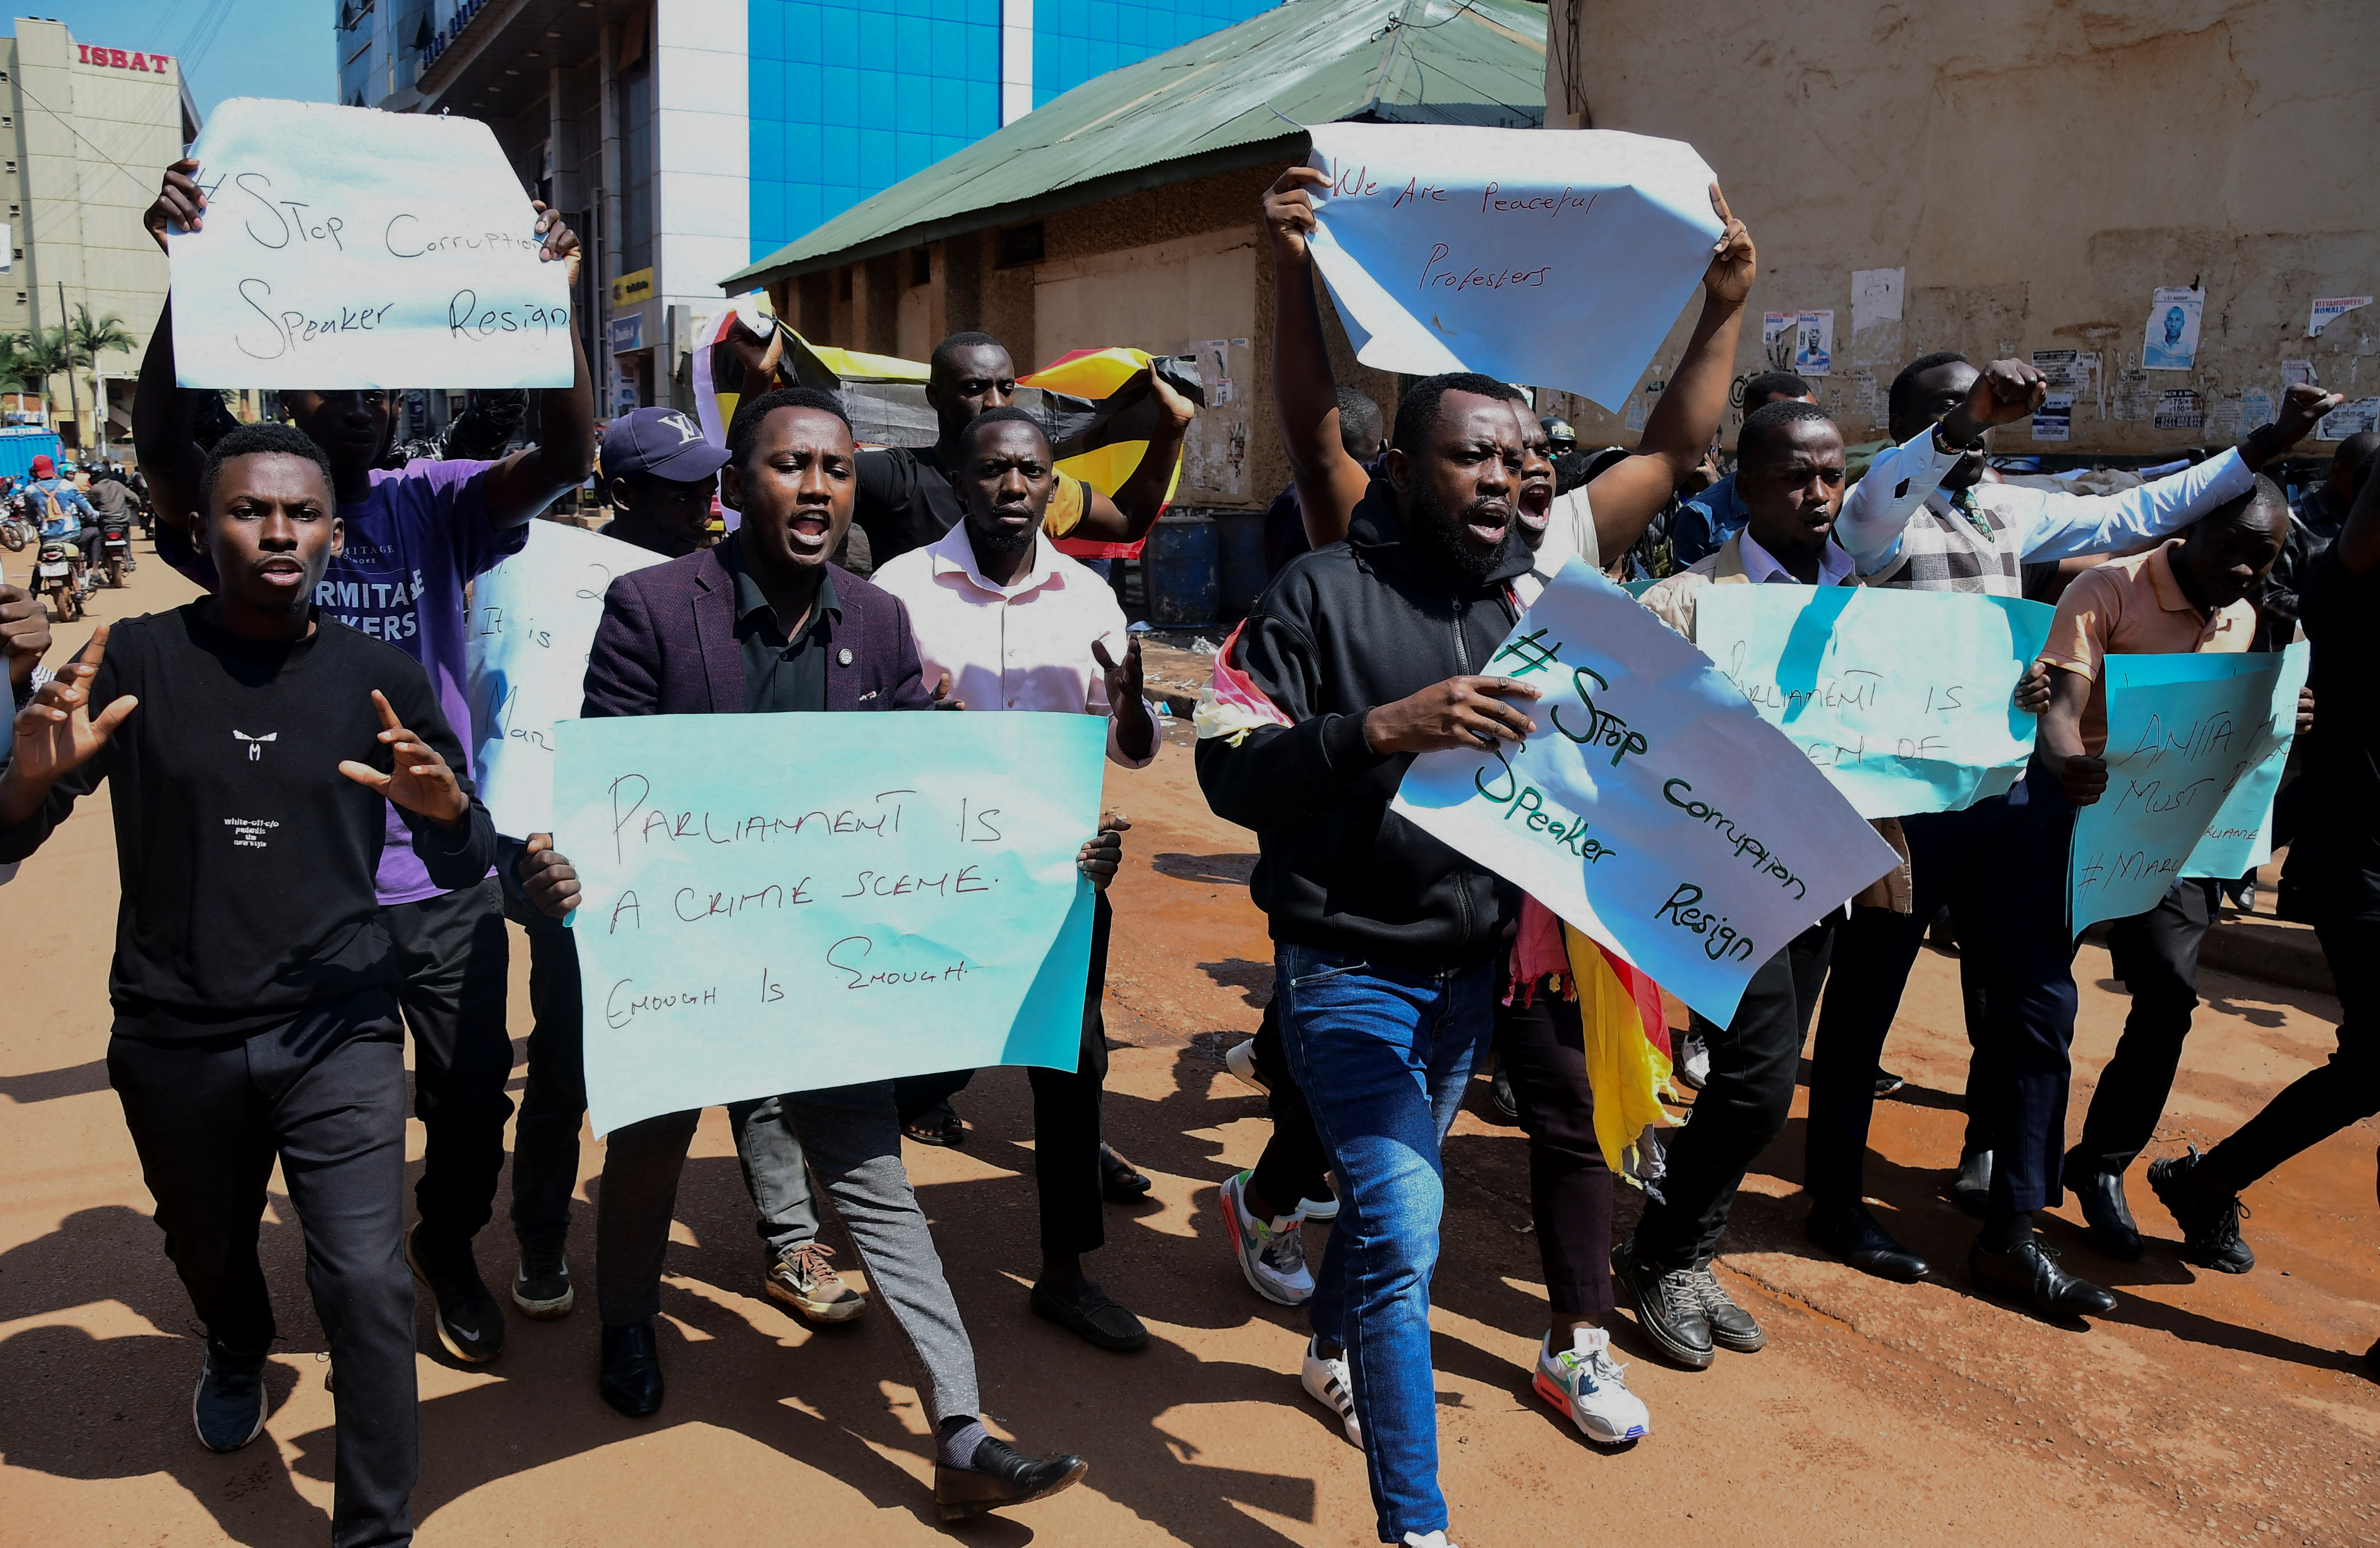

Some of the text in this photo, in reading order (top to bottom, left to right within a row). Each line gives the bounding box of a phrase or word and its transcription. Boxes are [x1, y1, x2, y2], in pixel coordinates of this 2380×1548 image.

[78, 44, 169, 74] ISBAT
[1332, 157, 1598, 217] We Are Peaceful
[1420, 243, 1552, 290] Protesters
[236, 279, 567, 359] Speaker Resign
[481, 607, 550, 648] It is
[1925, 686, 1962, 714] IS
[1898, 736, 1950, 761] OF
[2118, 711, 2233, 769] ANITA
[608, 774, 1002, 865] PARLIAMENT IS
[2113, 778, 2215, 815] MUST
[1662, 777, 1807, 901] Corruption
[610, 890, 640, 935] A
[675, 877, 814, 922] CRIME
[1654, 881, 1755, 963] Resign
